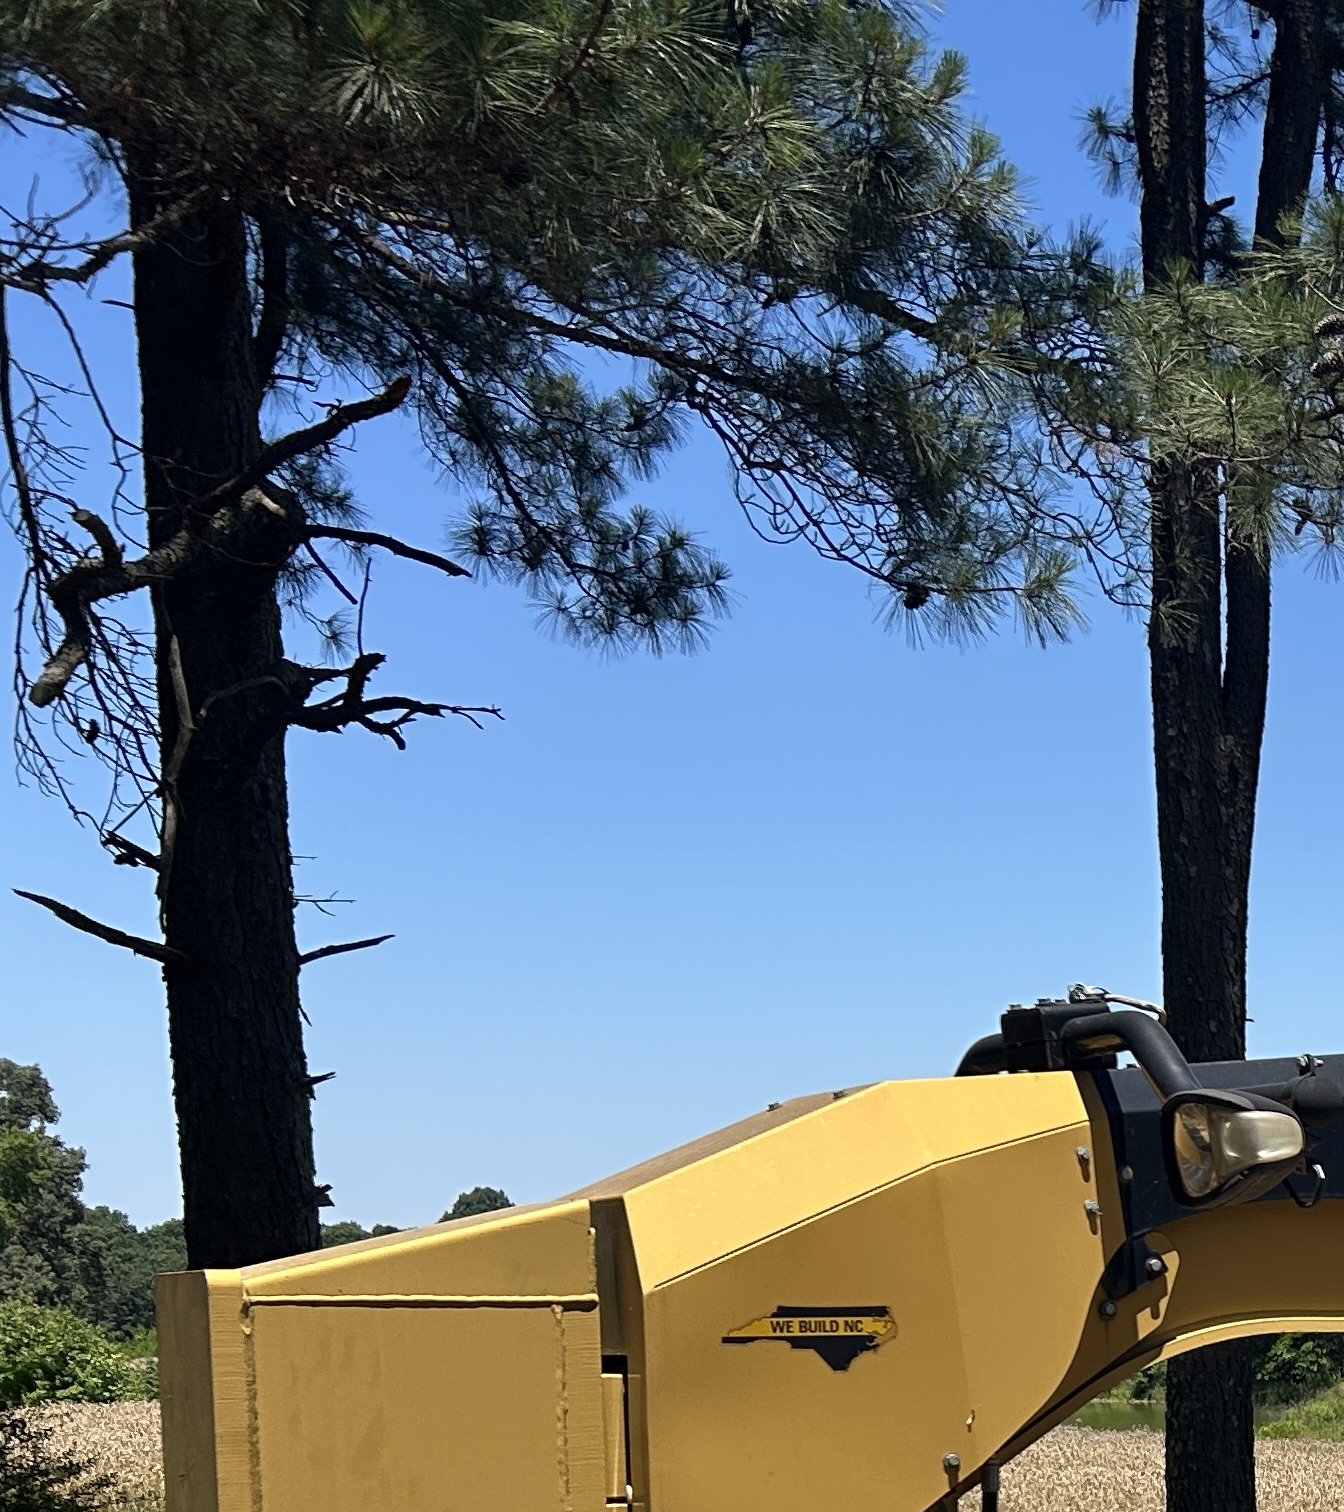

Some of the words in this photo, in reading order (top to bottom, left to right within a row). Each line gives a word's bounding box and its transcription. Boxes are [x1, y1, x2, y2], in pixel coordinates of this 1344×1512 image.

[770, 1320, 794, 1334] WE
[798, 1319, 839, 1334] BUILD
[844, 1319, 864, 1333] NC
